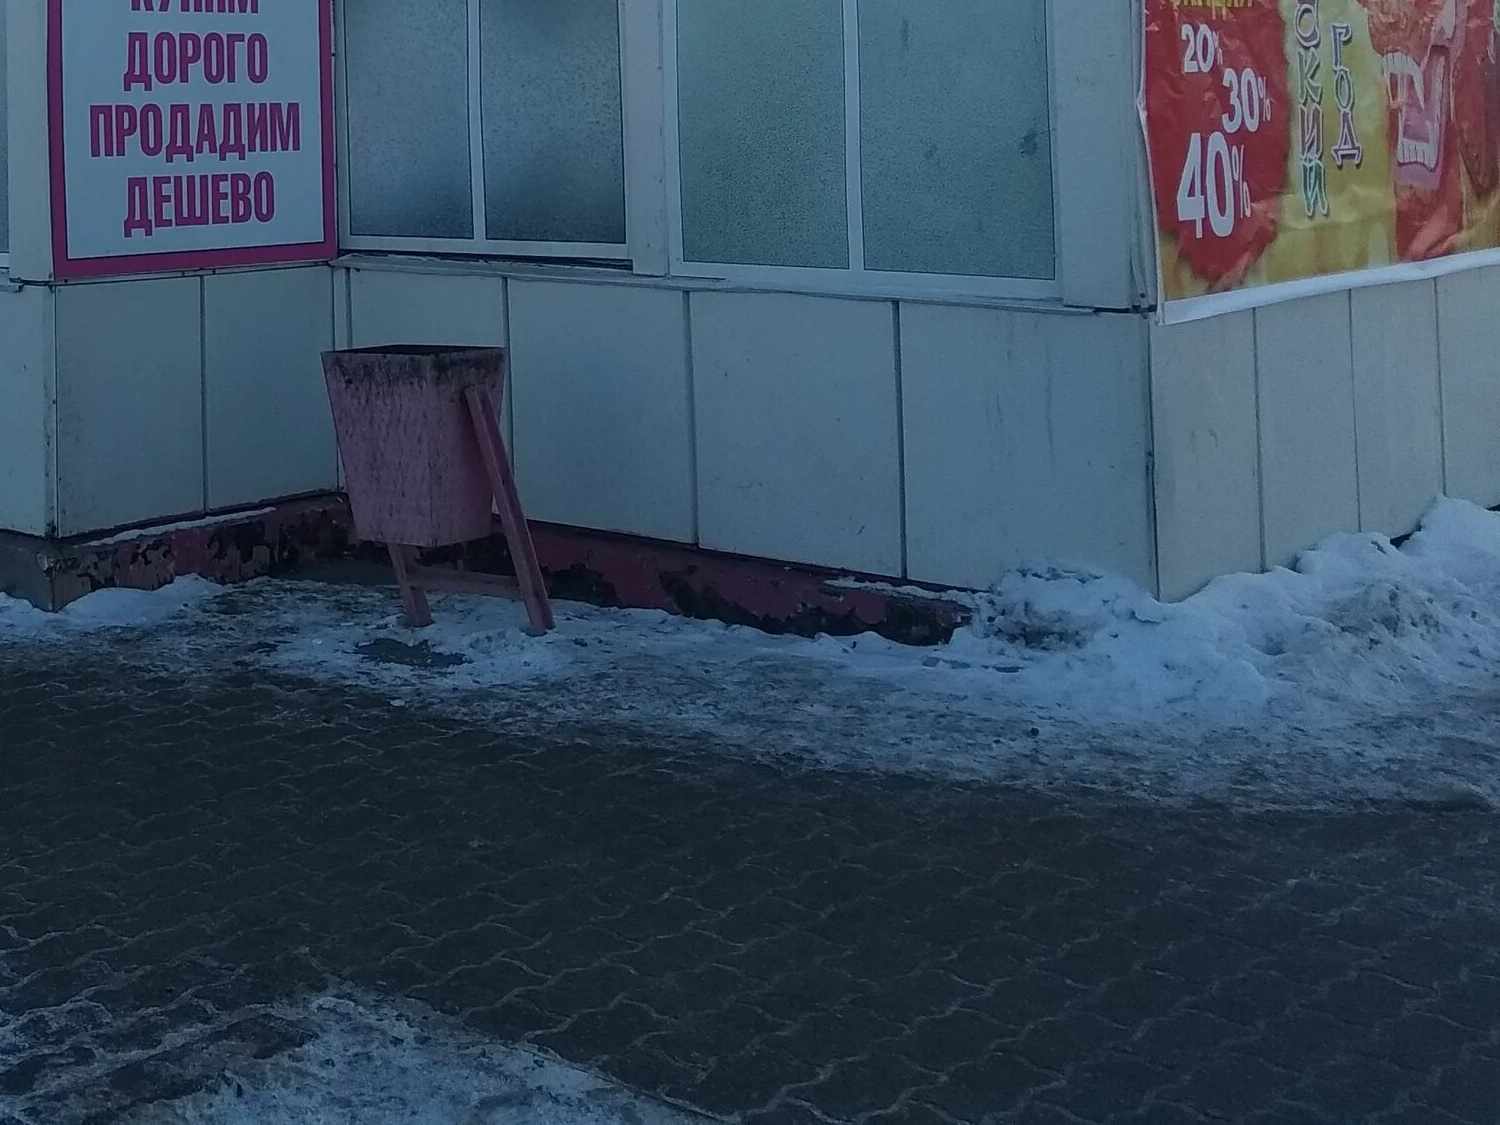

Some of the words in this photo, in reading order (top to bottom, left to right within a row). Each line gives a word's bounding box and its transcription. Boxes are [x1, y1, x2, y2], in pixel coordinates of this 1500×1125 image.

[123, 31, 269, 92] ДОРОГО
[1181, 24, 1223, 74] 20%
[1222, 68, 1272, 134] 30%
[1331, 24, 1363, 167] ГОД
[89, 102, 301, 163] ПРОДАДИМ
[123, 171, 275, 238] ДЕШЕВО
[1176, 131, 1251, 239] 40%
